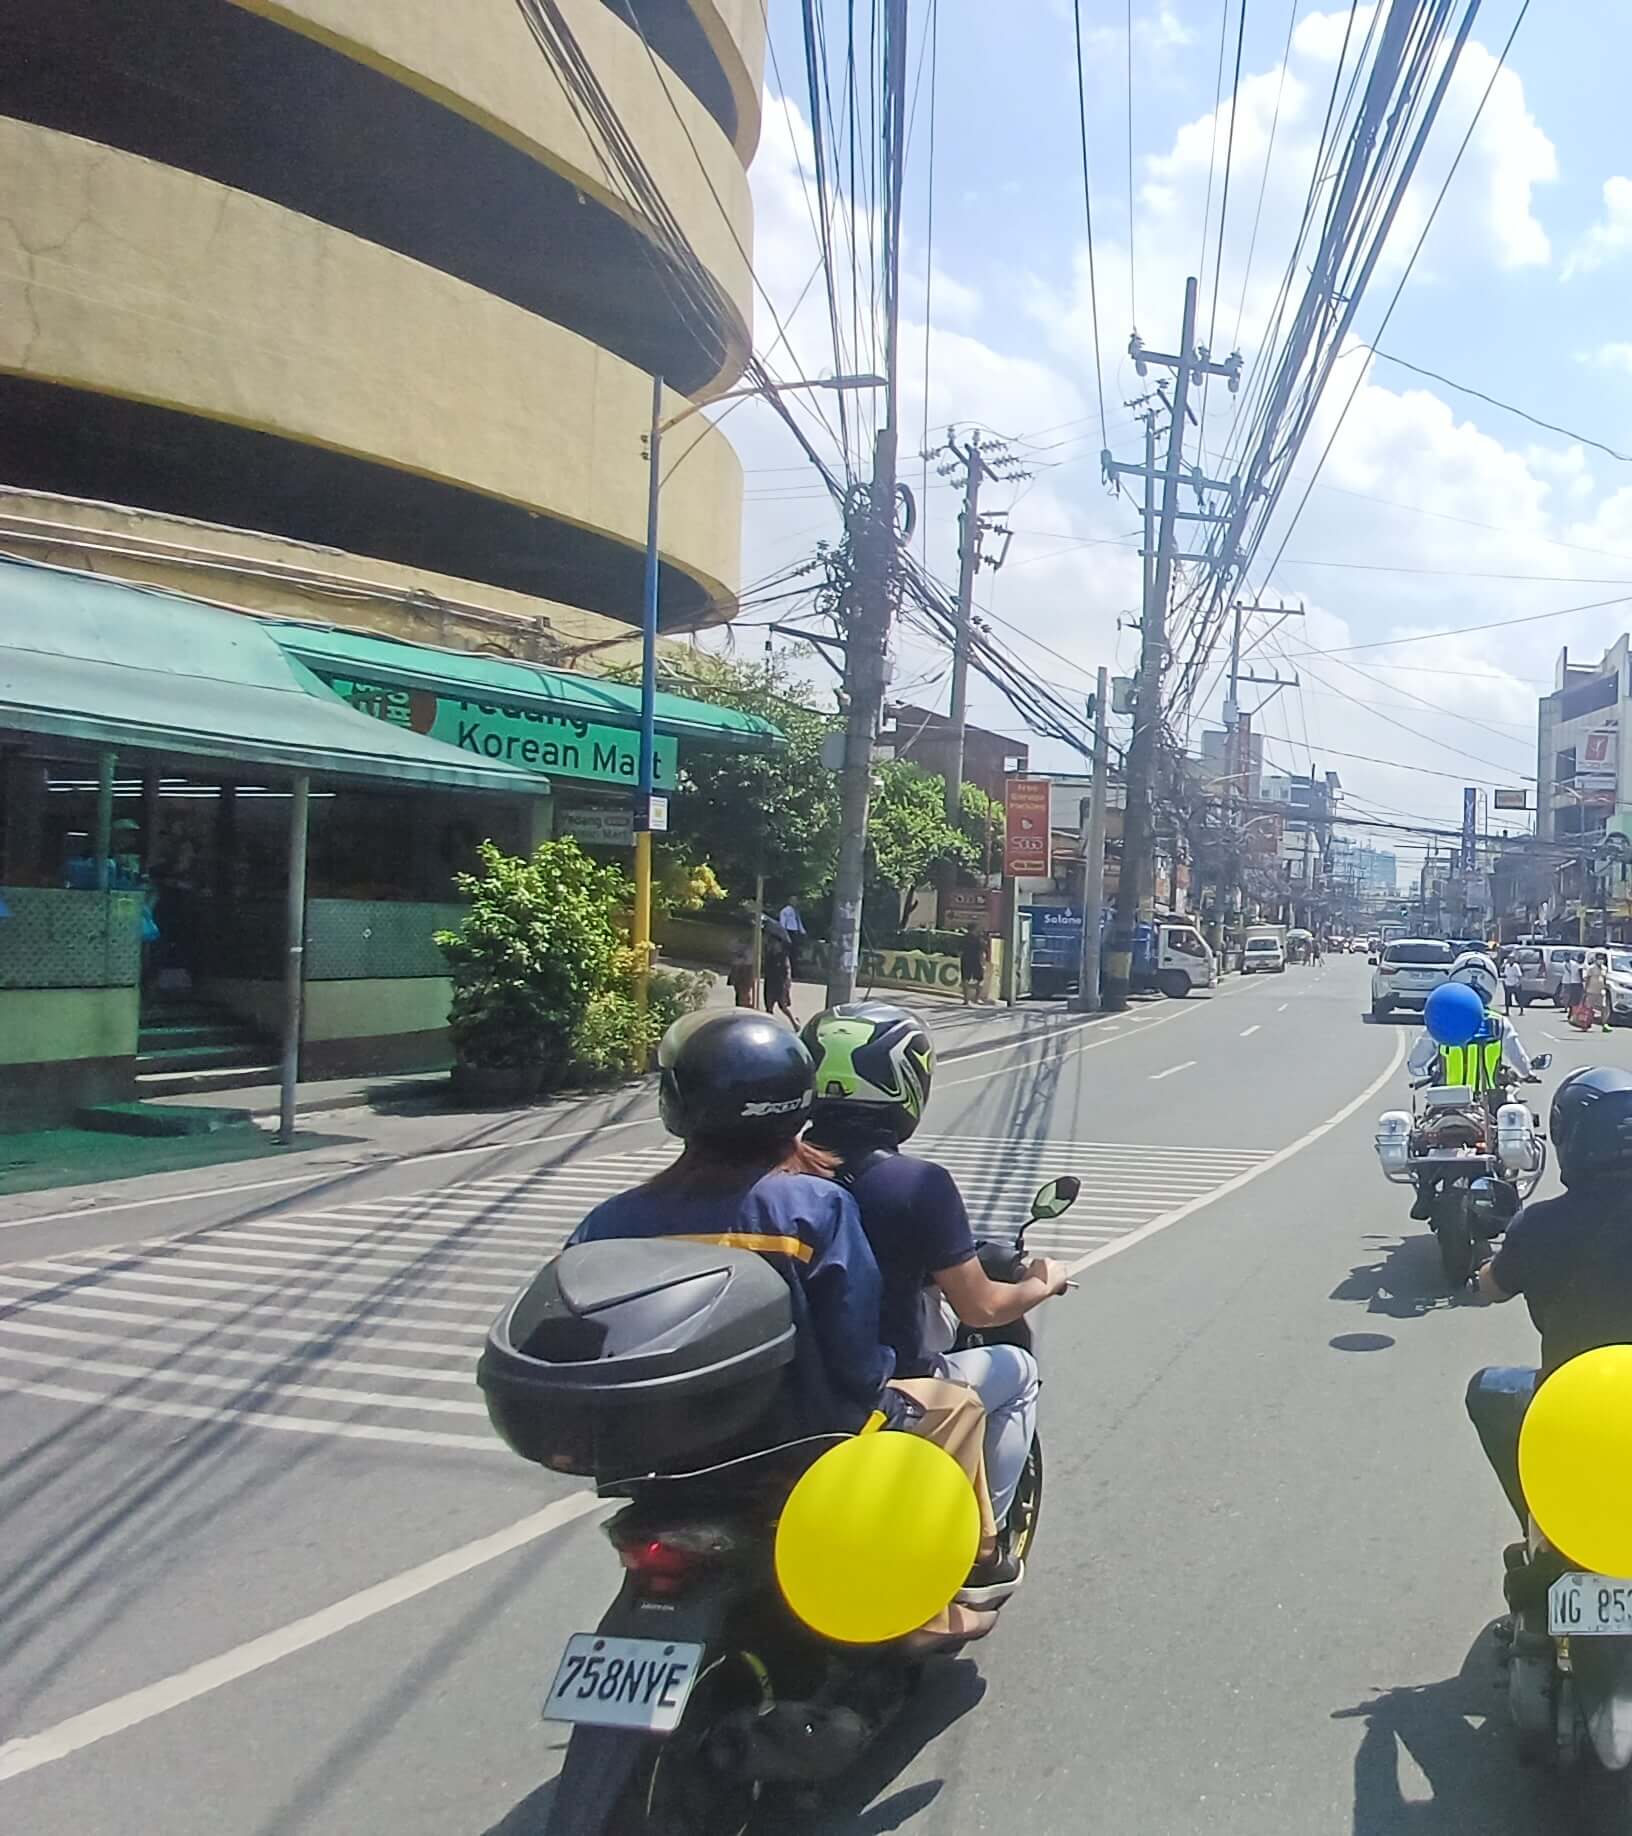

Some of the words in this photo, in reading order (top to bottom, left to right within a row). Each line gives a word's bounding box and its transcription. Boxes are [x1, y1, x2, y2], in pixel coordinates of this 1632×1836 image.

[458, 720, 580, 769] Korean
[592, 742, 662, 780] Mat
[1554, 1588, 1581, 1624] NG
[556, 1655, 690, 1708] 758NYE
